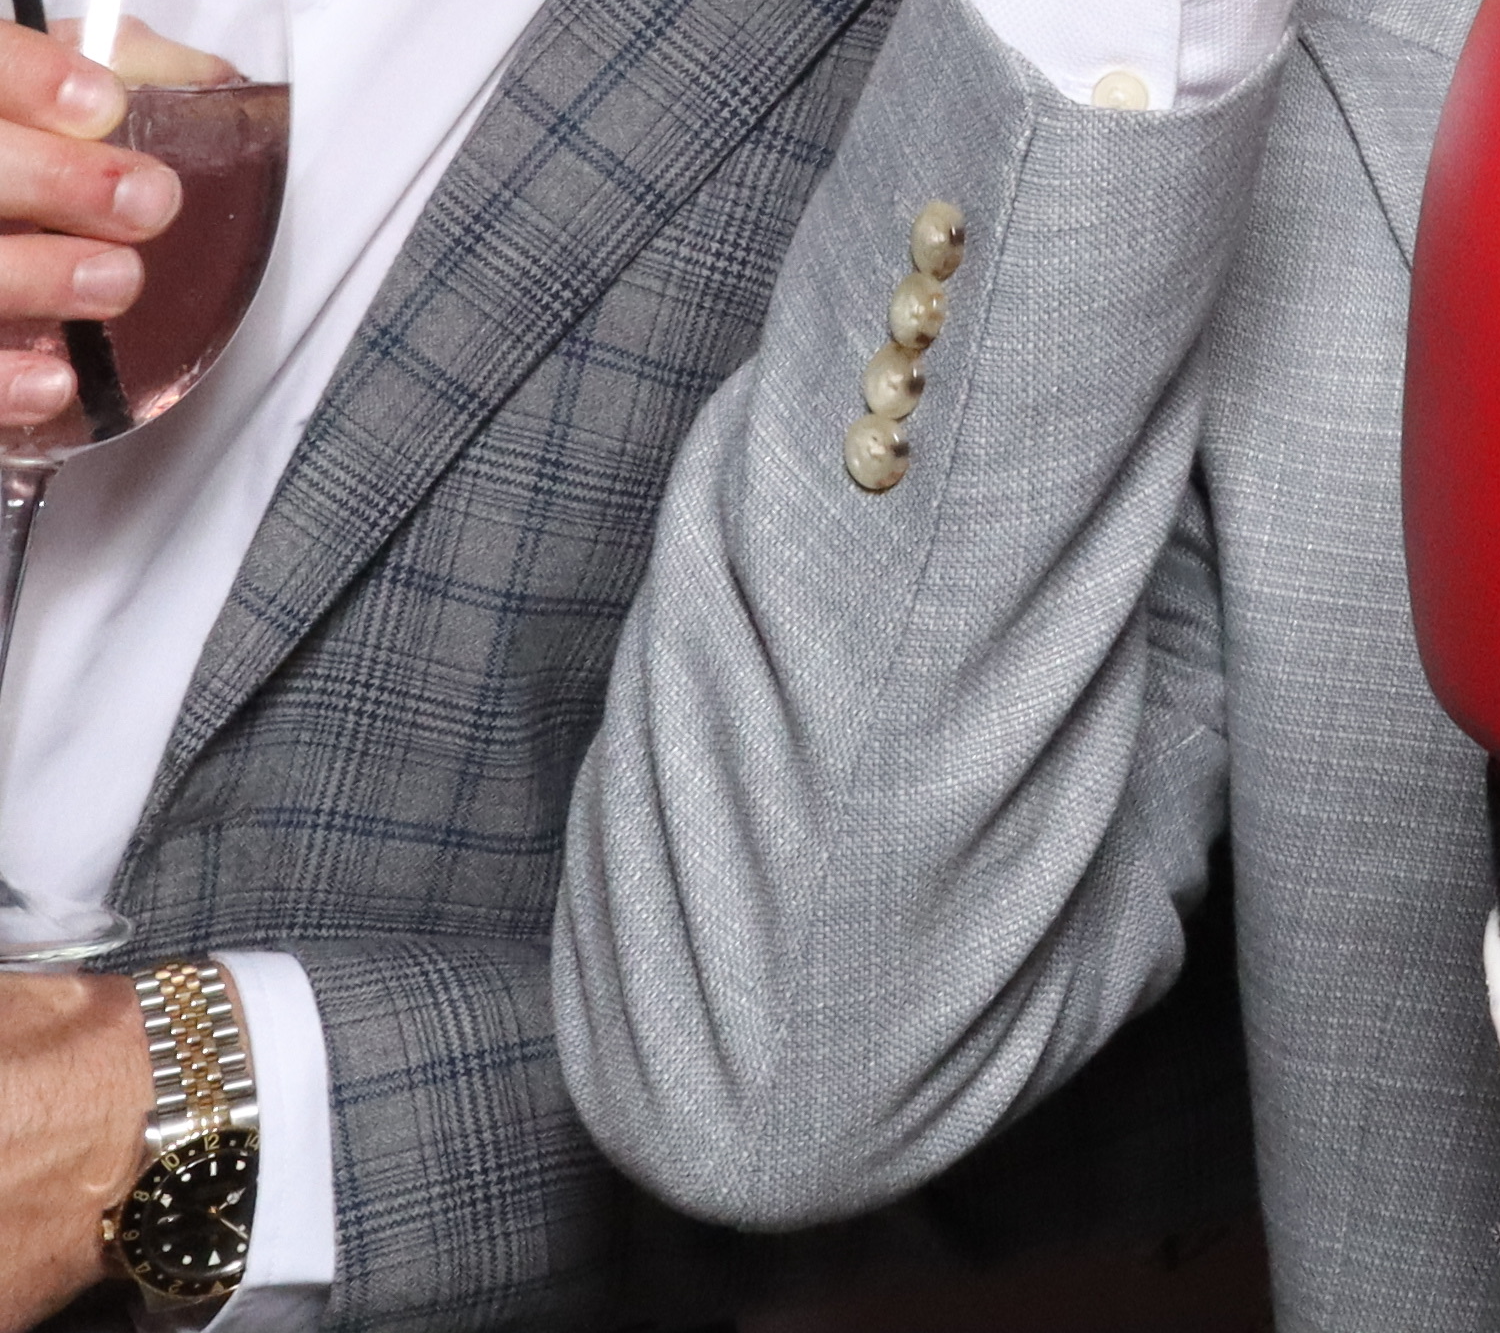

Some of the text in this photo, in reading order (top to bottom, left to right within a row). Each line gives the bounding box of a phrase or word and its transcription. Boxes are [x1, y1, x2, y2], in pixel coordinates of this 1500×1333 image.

[203, 1134, 220, 1151] 12
[161, 1153, 181, 1172] 10
[133, 1190, 150, 1202] 8
